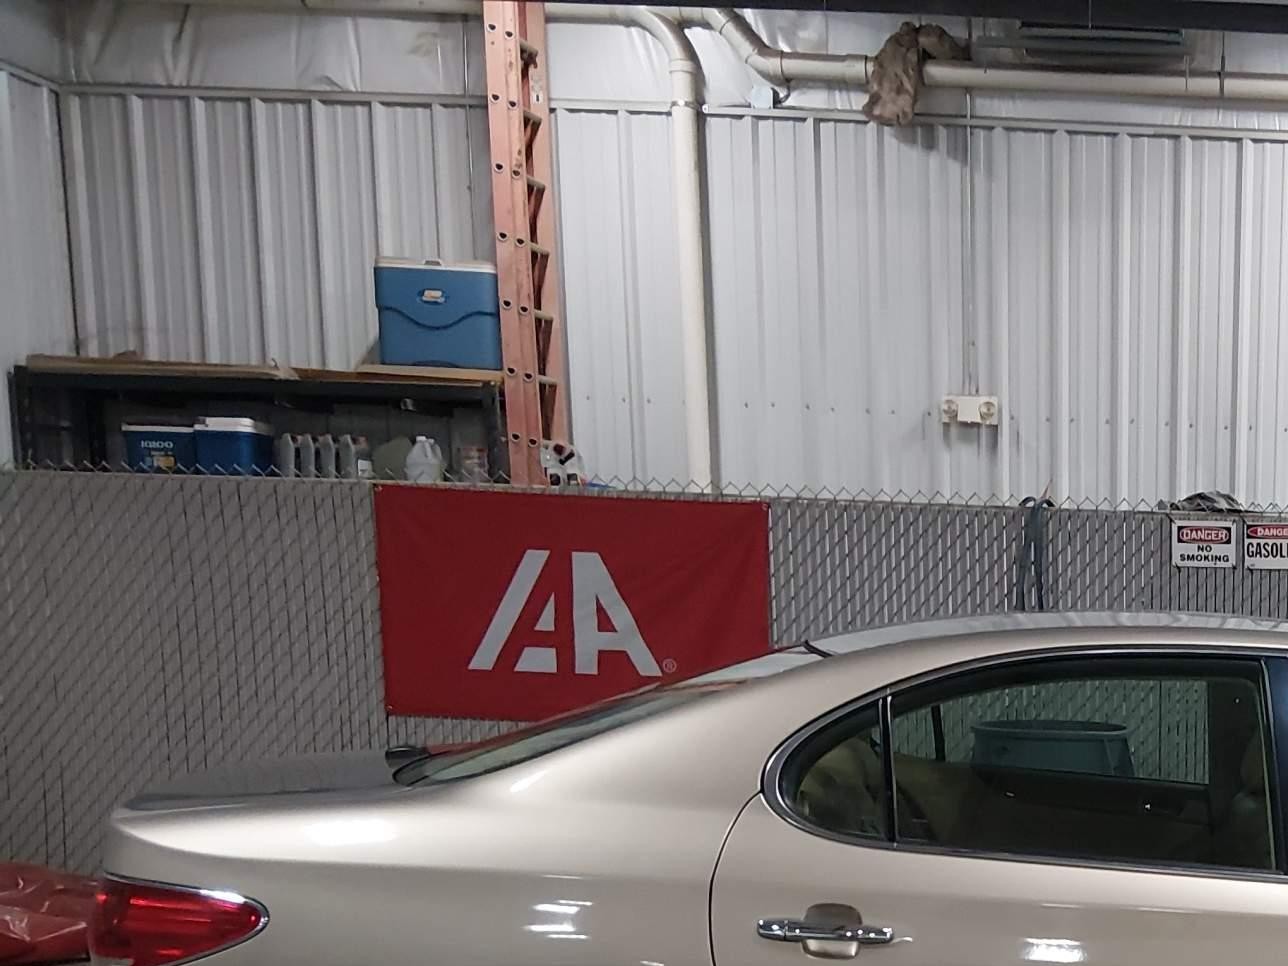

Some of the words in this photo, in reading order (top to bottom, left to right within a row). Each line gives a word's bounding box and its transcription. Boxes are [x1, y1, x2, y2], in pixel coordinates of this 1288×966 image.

[1183, 529, 1226, 541] DANGER
[1197, 544, 1213, 553] NO
[1179, 553, 1230, 563] SMOKING
